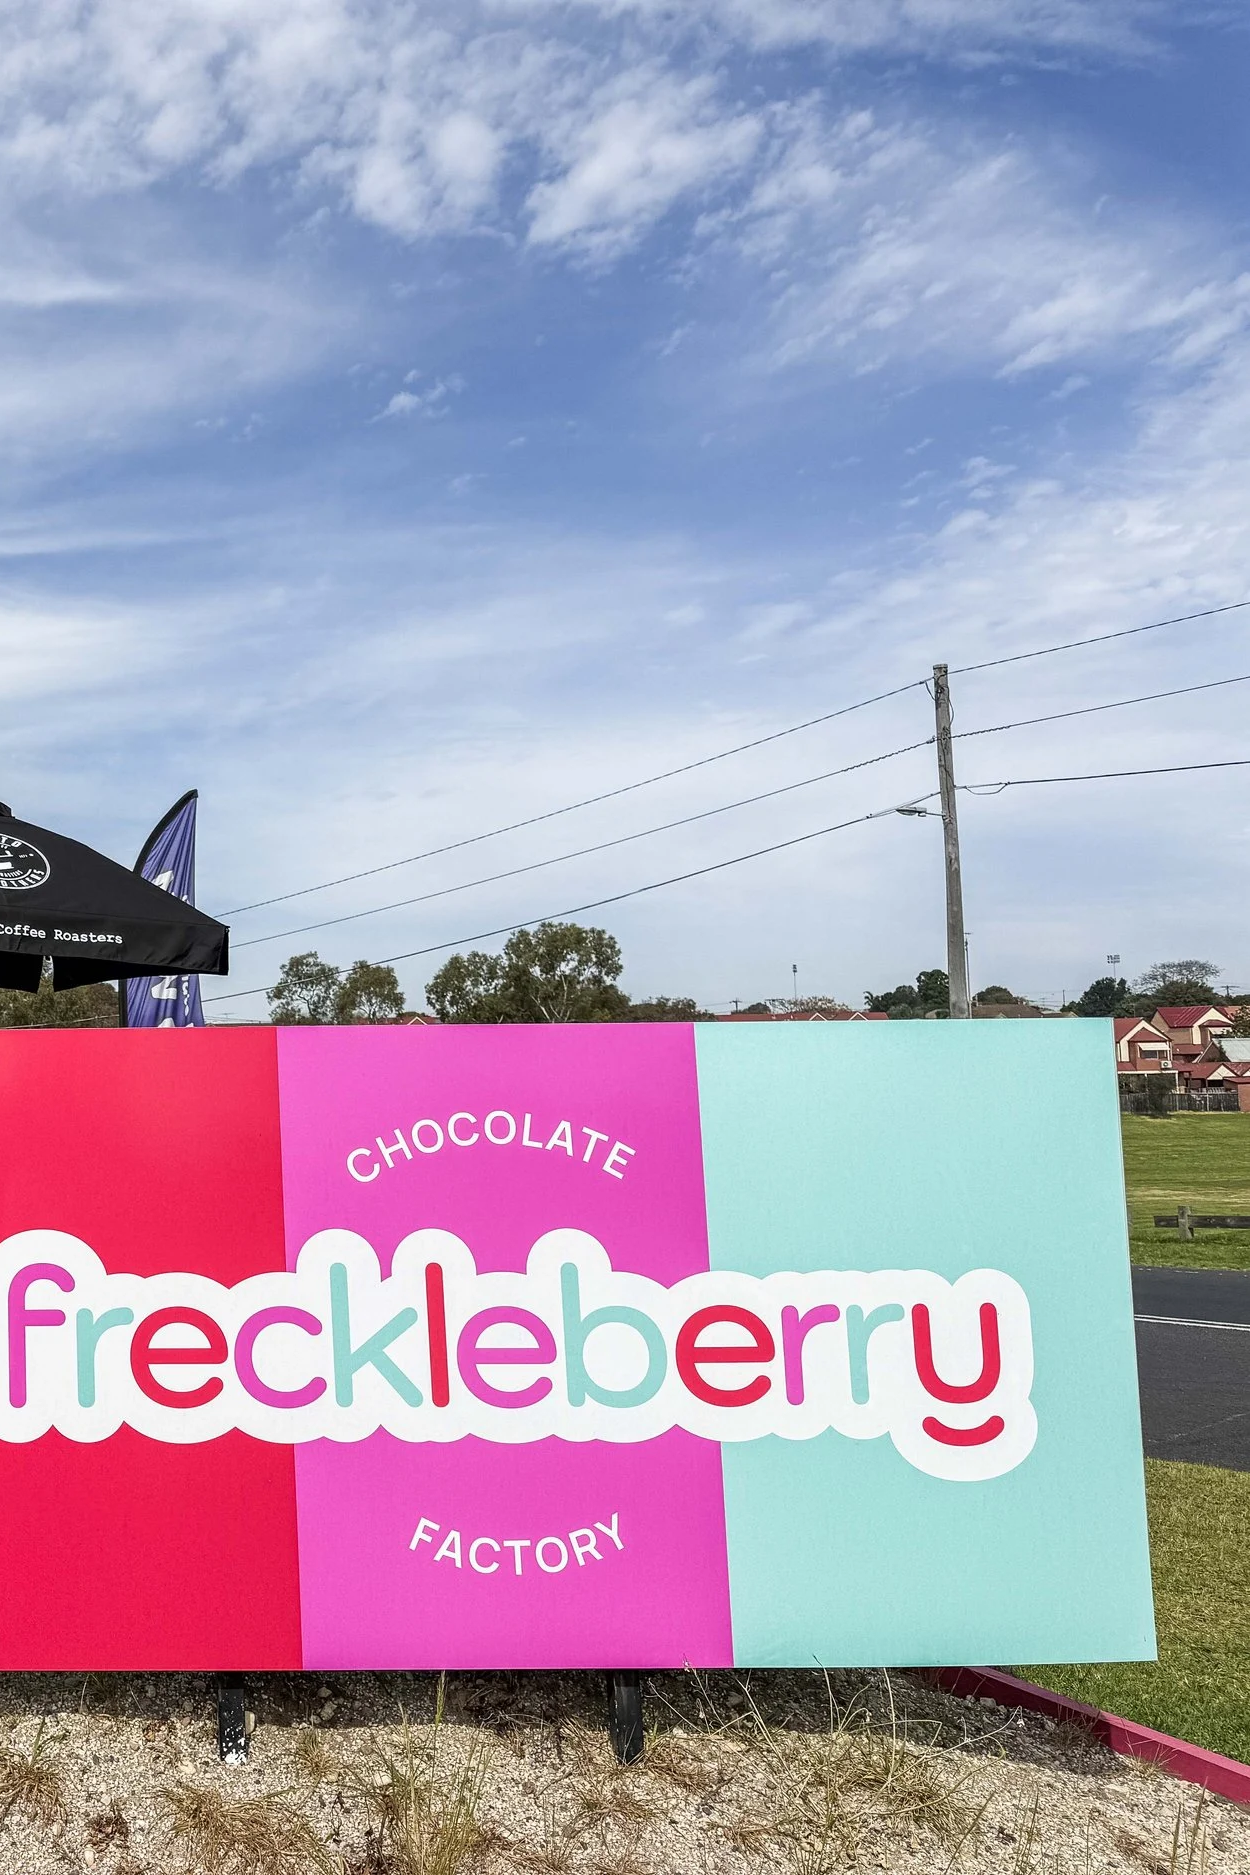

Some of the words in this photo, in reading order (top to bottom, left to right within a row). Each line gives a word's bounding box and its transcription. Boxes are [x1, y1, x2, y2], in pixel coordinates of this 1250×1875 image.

[53, 929, 123, 944] Roasters
[346, 1110, 636, 1183] CHOCOLATE
[7, 1261, 1003, 1447] freckleberry
[408, 1512, 625, 1575] FACTORY
